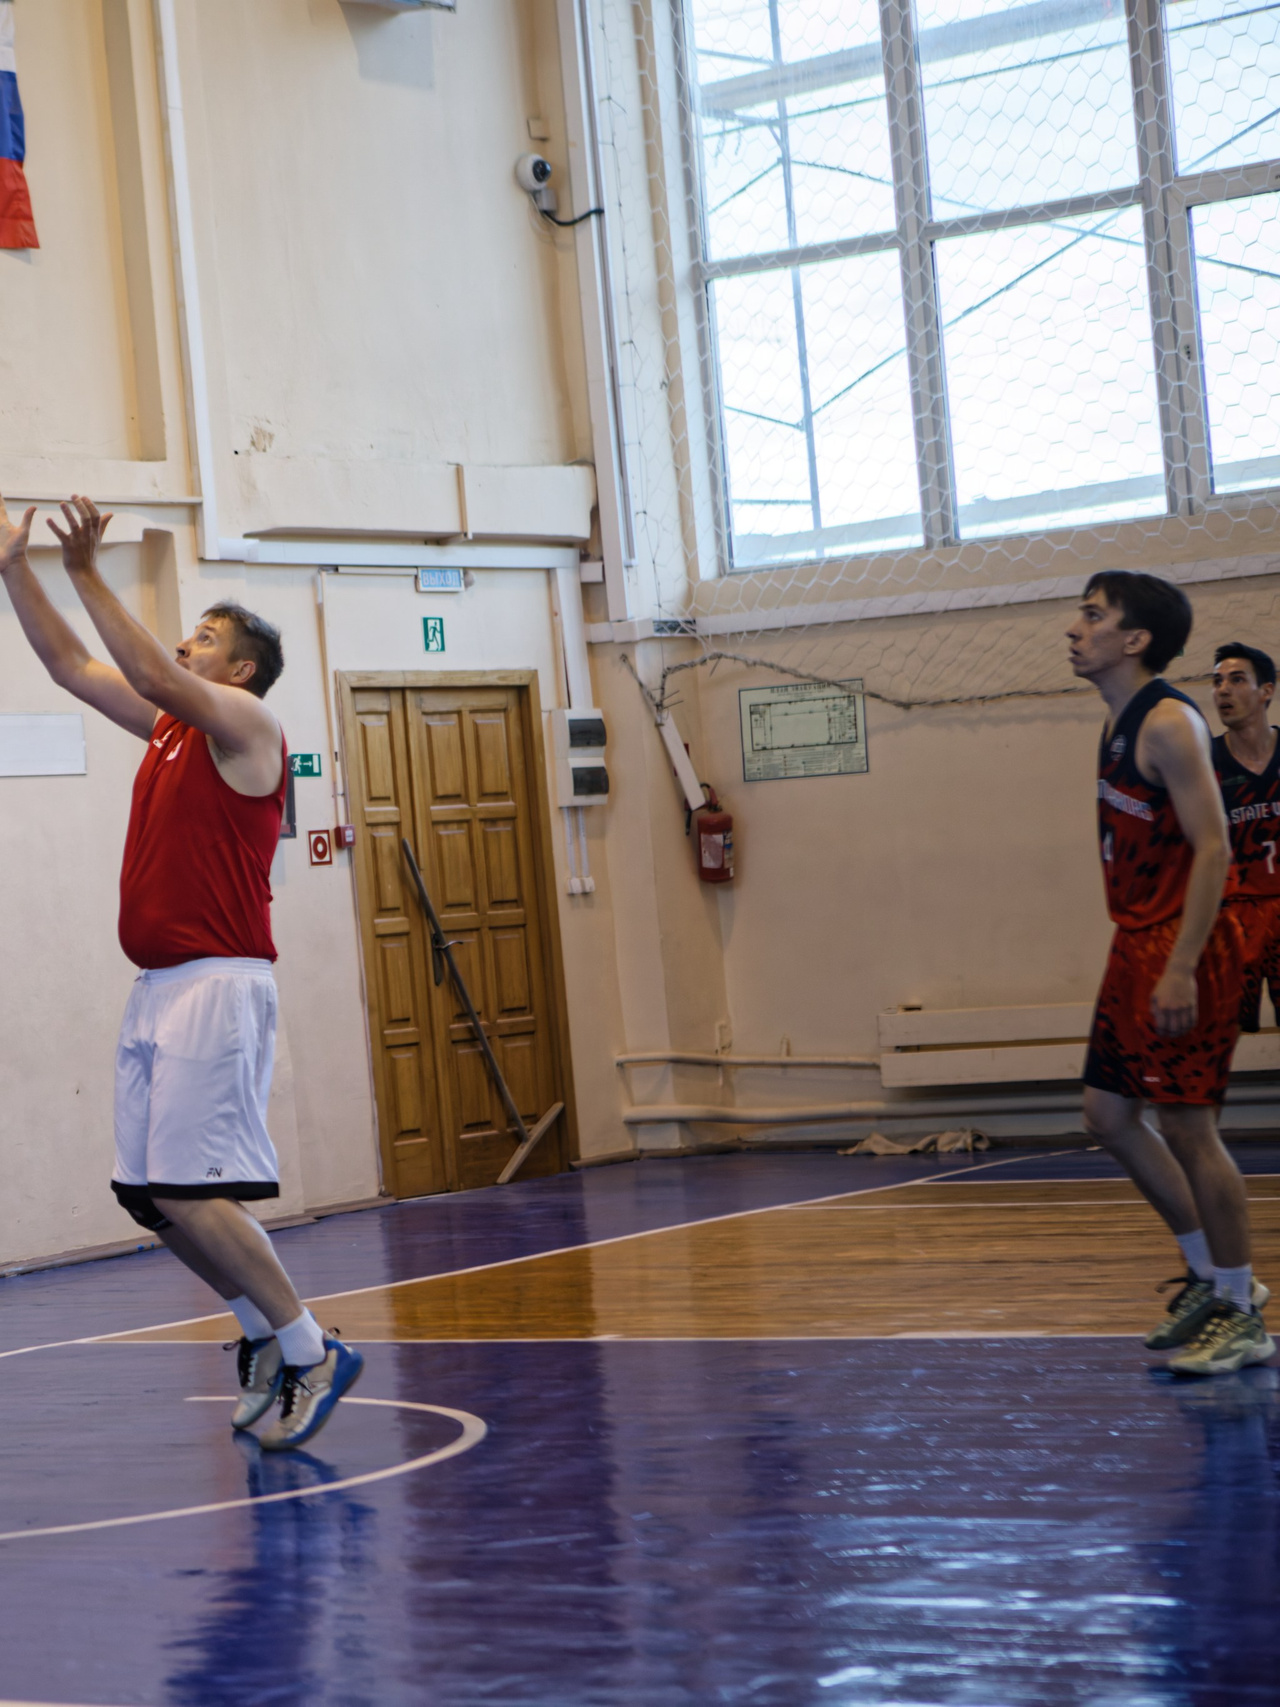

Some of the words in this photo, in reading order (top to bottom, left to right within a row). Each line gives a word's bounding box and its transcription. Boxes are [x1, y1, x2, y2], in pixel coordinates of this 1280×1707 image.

[422, 571, 459, 586] ВЫХОД
[1230, 803, 1271, 824] STATE
[1261, 841, 1276, 874] 7
